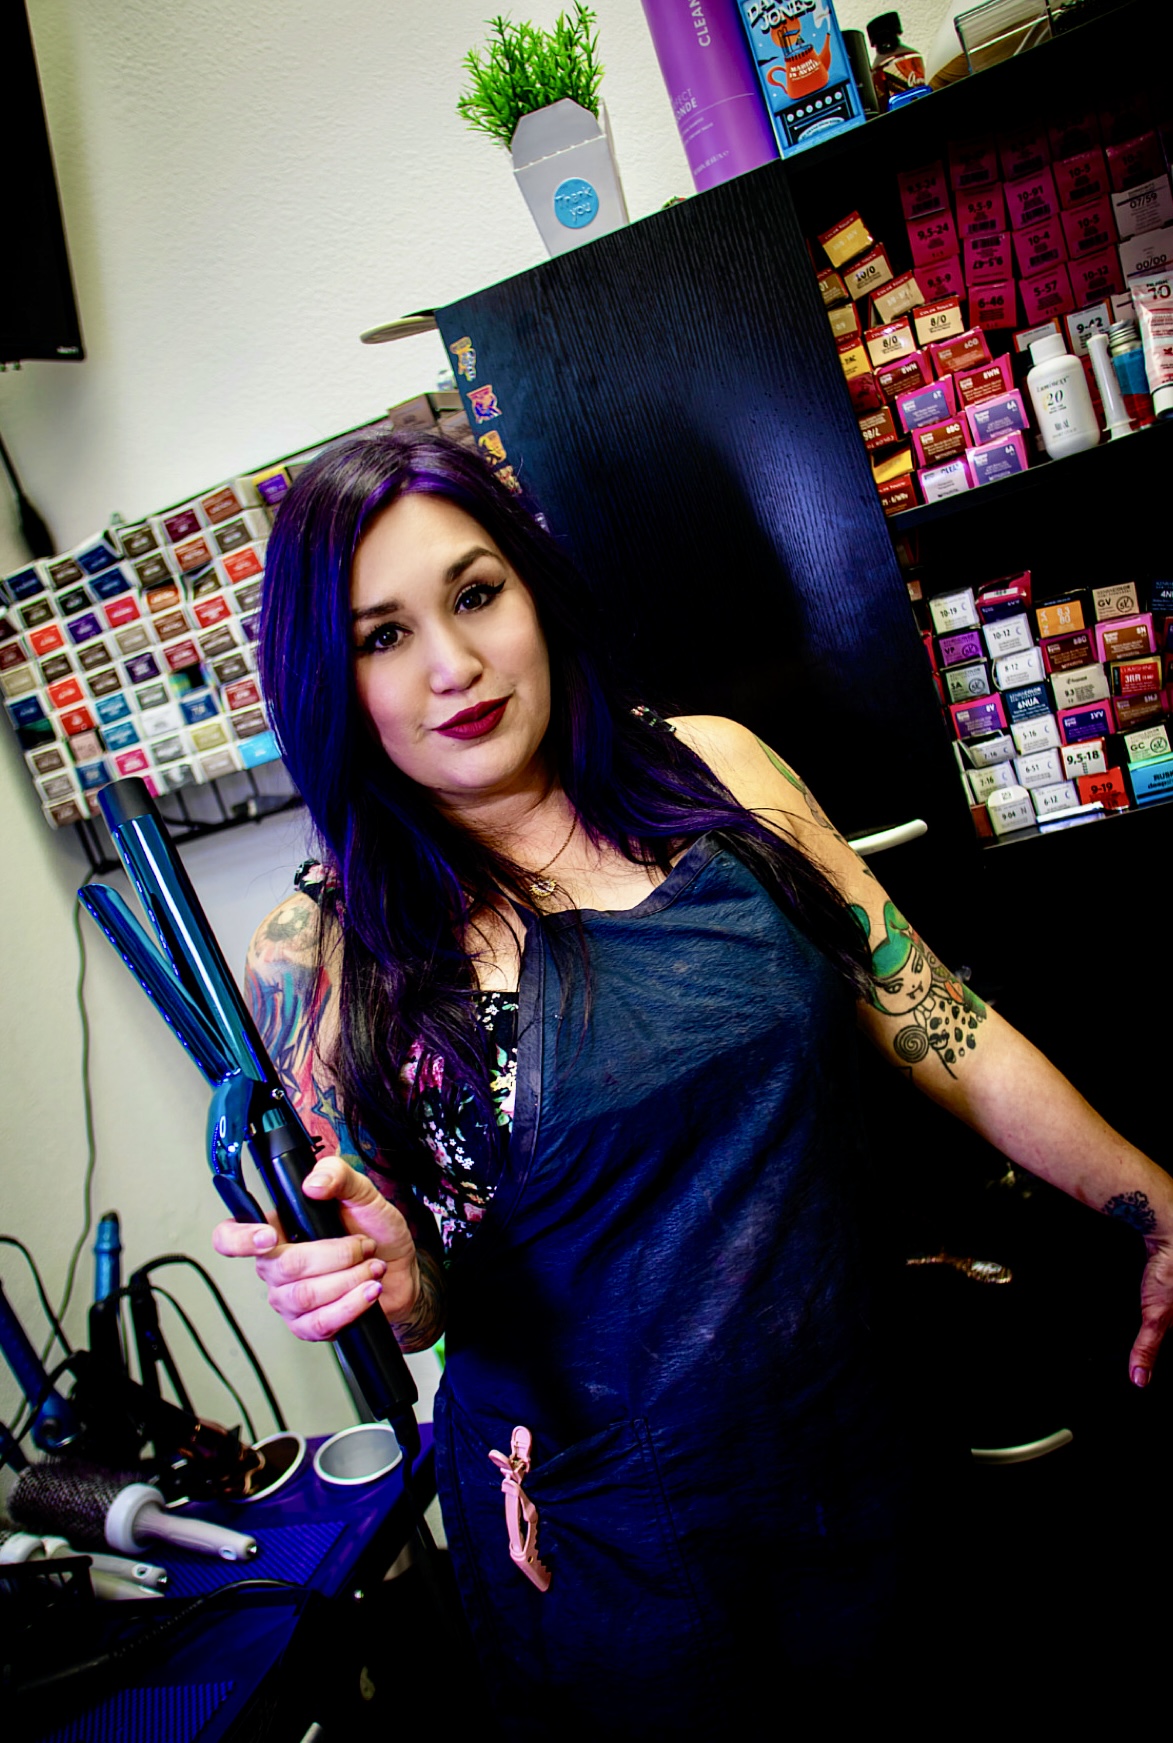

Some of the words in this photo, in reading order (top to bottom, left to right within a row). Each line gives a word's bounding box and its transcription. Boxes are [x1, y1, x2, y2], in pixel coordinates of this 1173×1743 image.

[1129, 193, 1158, 209] 07/59
[569, 202, 592, 223] you
[1135, 254, 1167, 271] 00/00
[855, 265, 876, 281] 10/0
[1033, 281, 1058, 296] 5-57
[978, 296, 1004, 308] 6-46
[930, 315, 947, 327] 8/0
[882, 335, 898, 348] 8/0
[1047, 389, 1064, 406] 20
[1097, 598, 1112, 607] GV
[939, 607, 958, 618] 10-19
[993, 629, 1011, 640] 10-12
[1130, 742, 1145, 752] GC
[1066, 750, 1100, 765] 9,5-18
[1091, 782, 1113, 794] 9-19
[1043, 795, 1058, 806] 6-12
